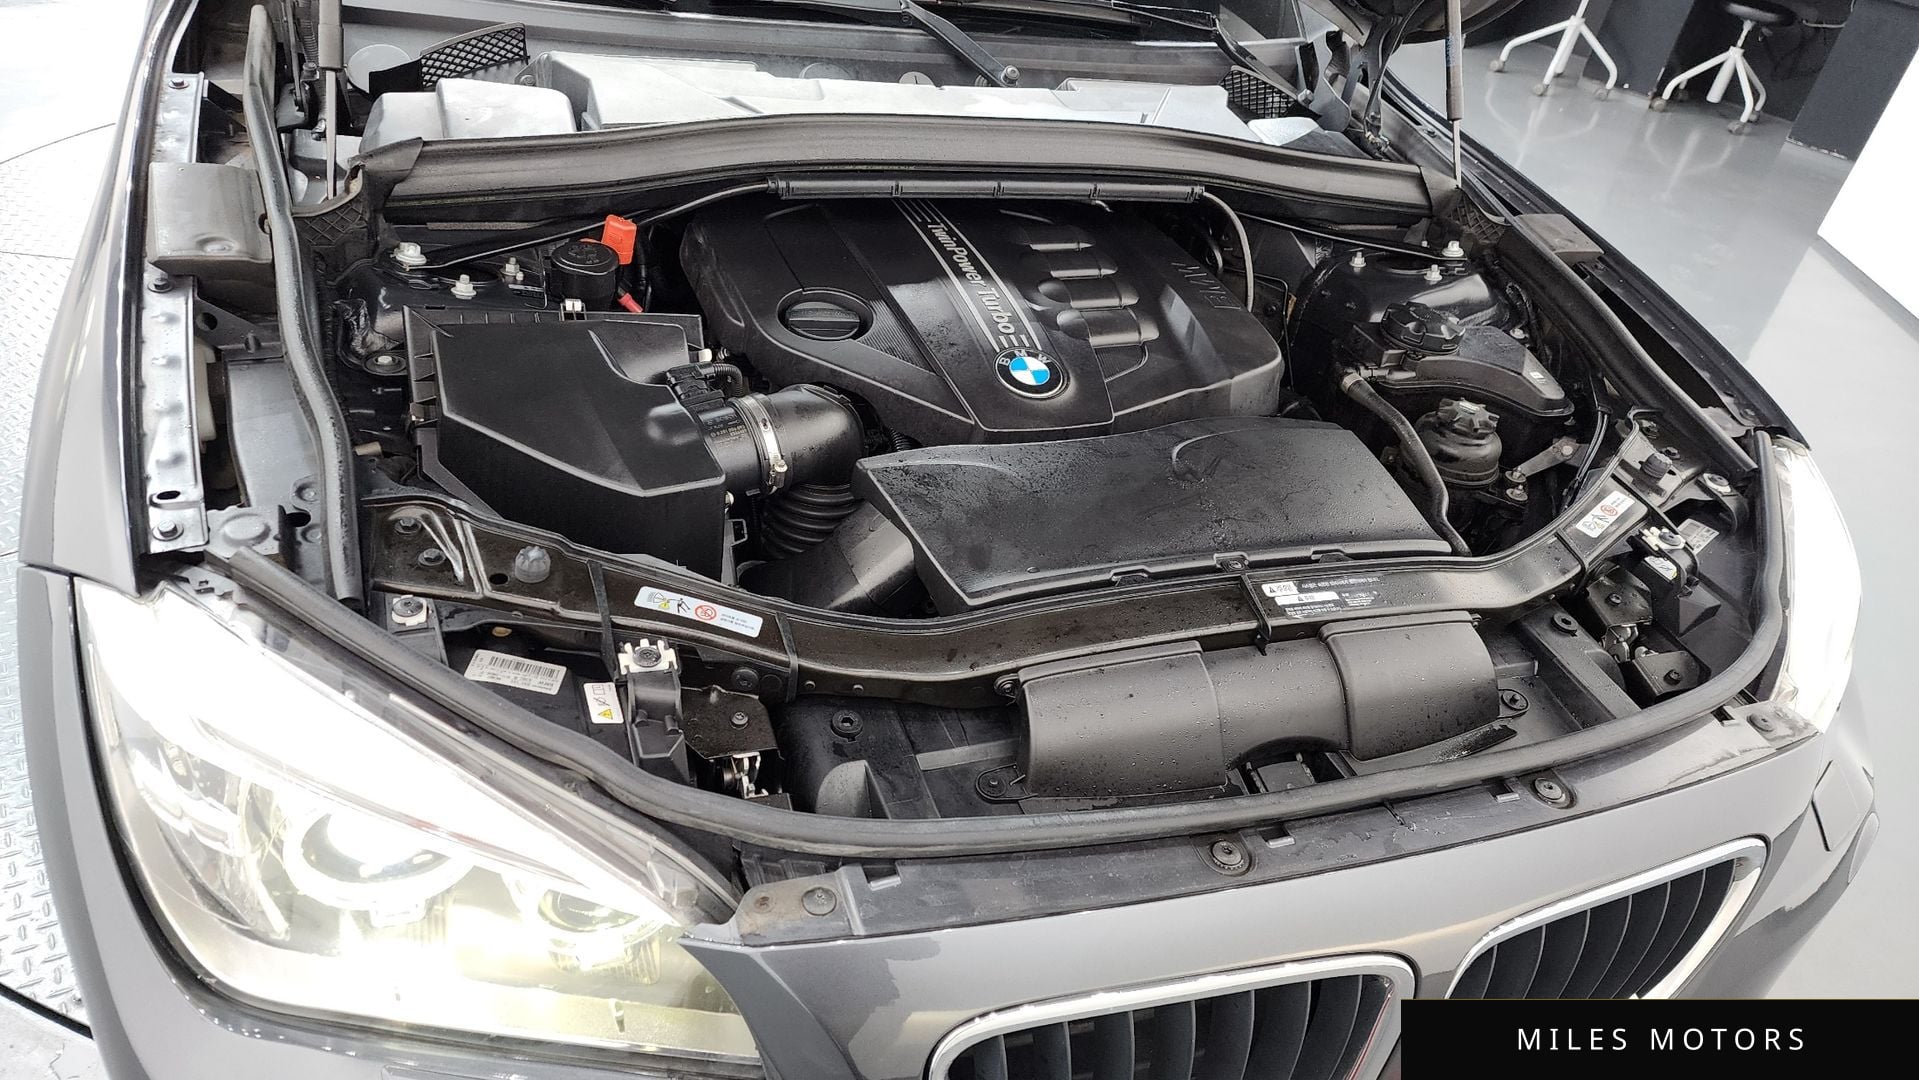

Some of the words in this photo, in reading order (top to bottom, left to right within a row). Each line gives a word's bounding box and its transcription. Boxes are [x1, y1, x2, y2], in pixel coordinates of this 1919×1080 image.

[928, 222, 986, 288] TwinPower
[977, 287, 1015, 334] Turbo
[998, 349, 1052, 367] BMW
